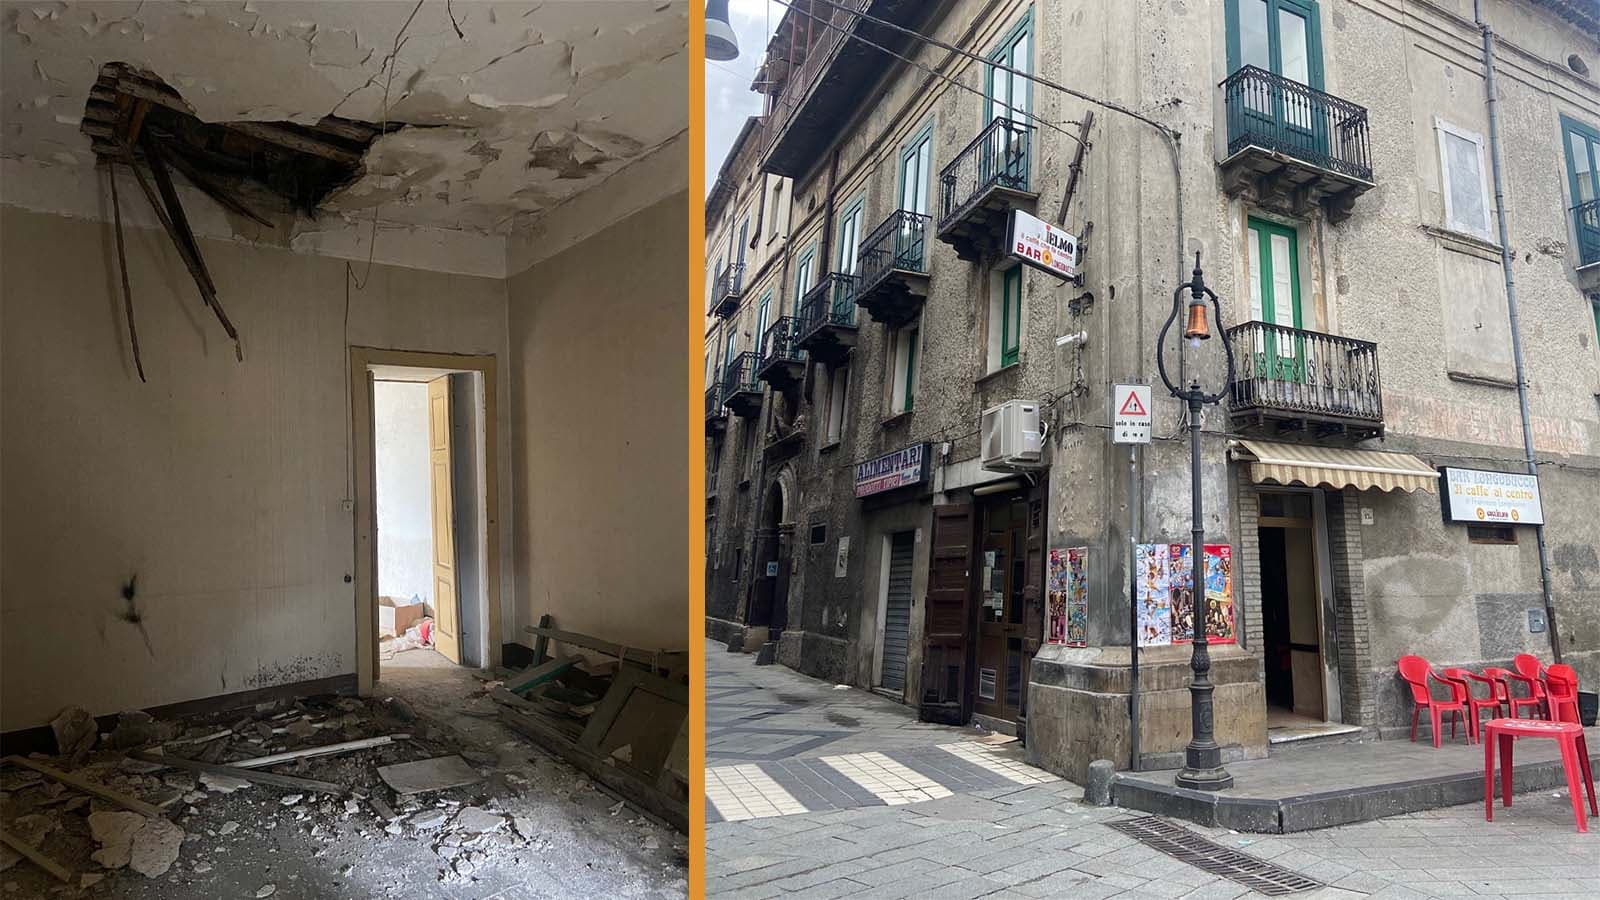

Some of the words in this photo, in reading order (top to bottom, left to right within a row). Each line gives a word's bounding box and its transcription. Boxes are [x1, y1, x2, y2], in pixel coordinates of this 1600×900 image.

[1017, 242, 1041, 261] BAR
[857, 446, 921, 482] ALIMENTARI
[1449, 470, 1471, 483] BAR
[1473, 472, 1535, 488] LONGOBUCCO
[1492, 487, 1502, 498] al
[1506, 488, 1533, 500] centro
